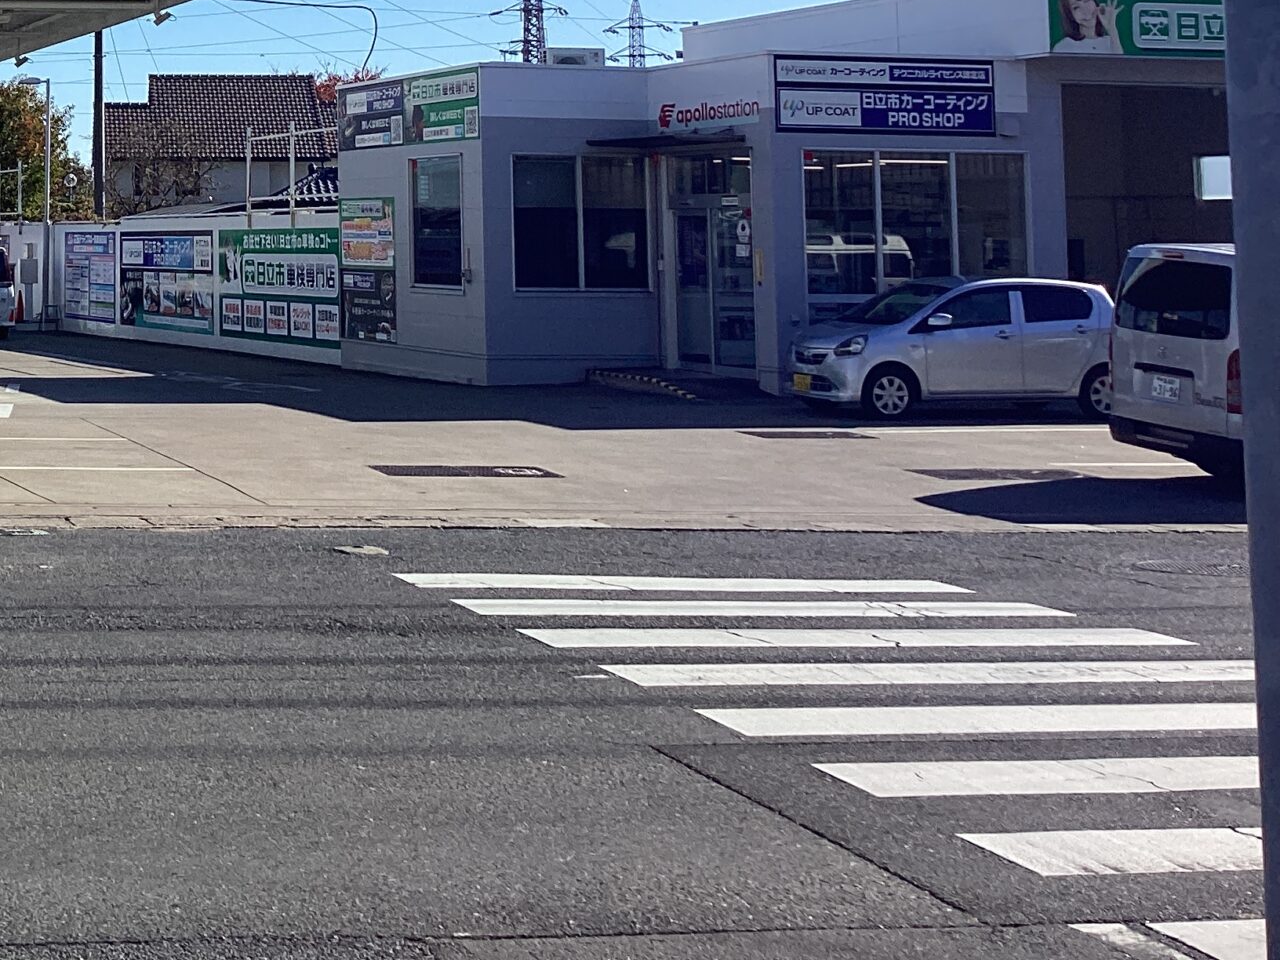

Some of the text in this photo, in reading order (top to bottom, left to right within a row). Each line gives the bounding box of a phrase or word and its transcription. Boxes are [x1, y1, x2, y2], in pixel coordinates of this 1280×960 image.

[829, 67, 887, 77] カーコーティング
[862, 92, 989, 111] 日立市カーコーティング
[676, 98, 760, 128] apollostation
[805, 106, 823, 116] UP
[824, 106, 858, 117] COAT
[888, 111, 965, 127] PRO SHOP
